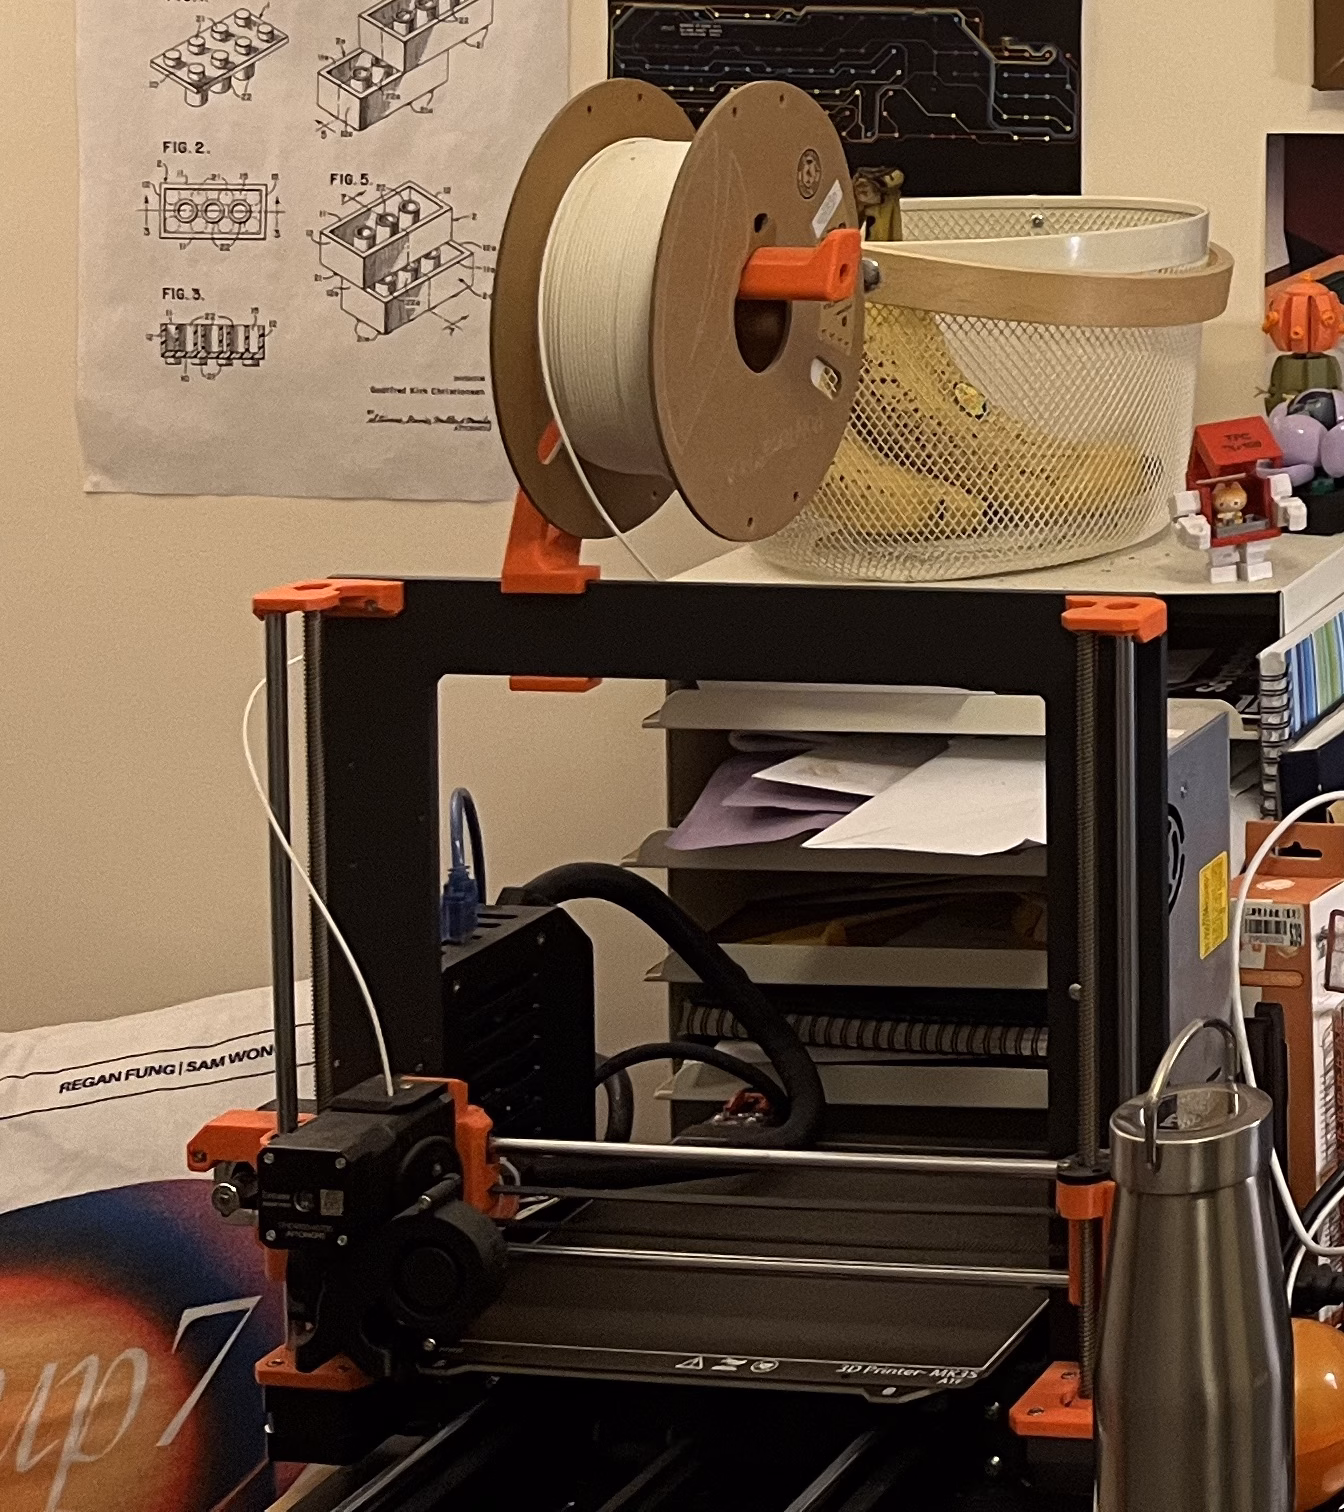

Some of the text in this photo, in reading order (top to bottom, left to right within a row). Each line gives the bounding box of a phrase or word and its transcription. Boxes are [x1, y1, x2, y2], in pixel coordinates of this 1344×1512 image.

[58, 1043, 276, 1094] REGAN FUNG SAM WON
[835, 1364, 862, 1373] 3D
